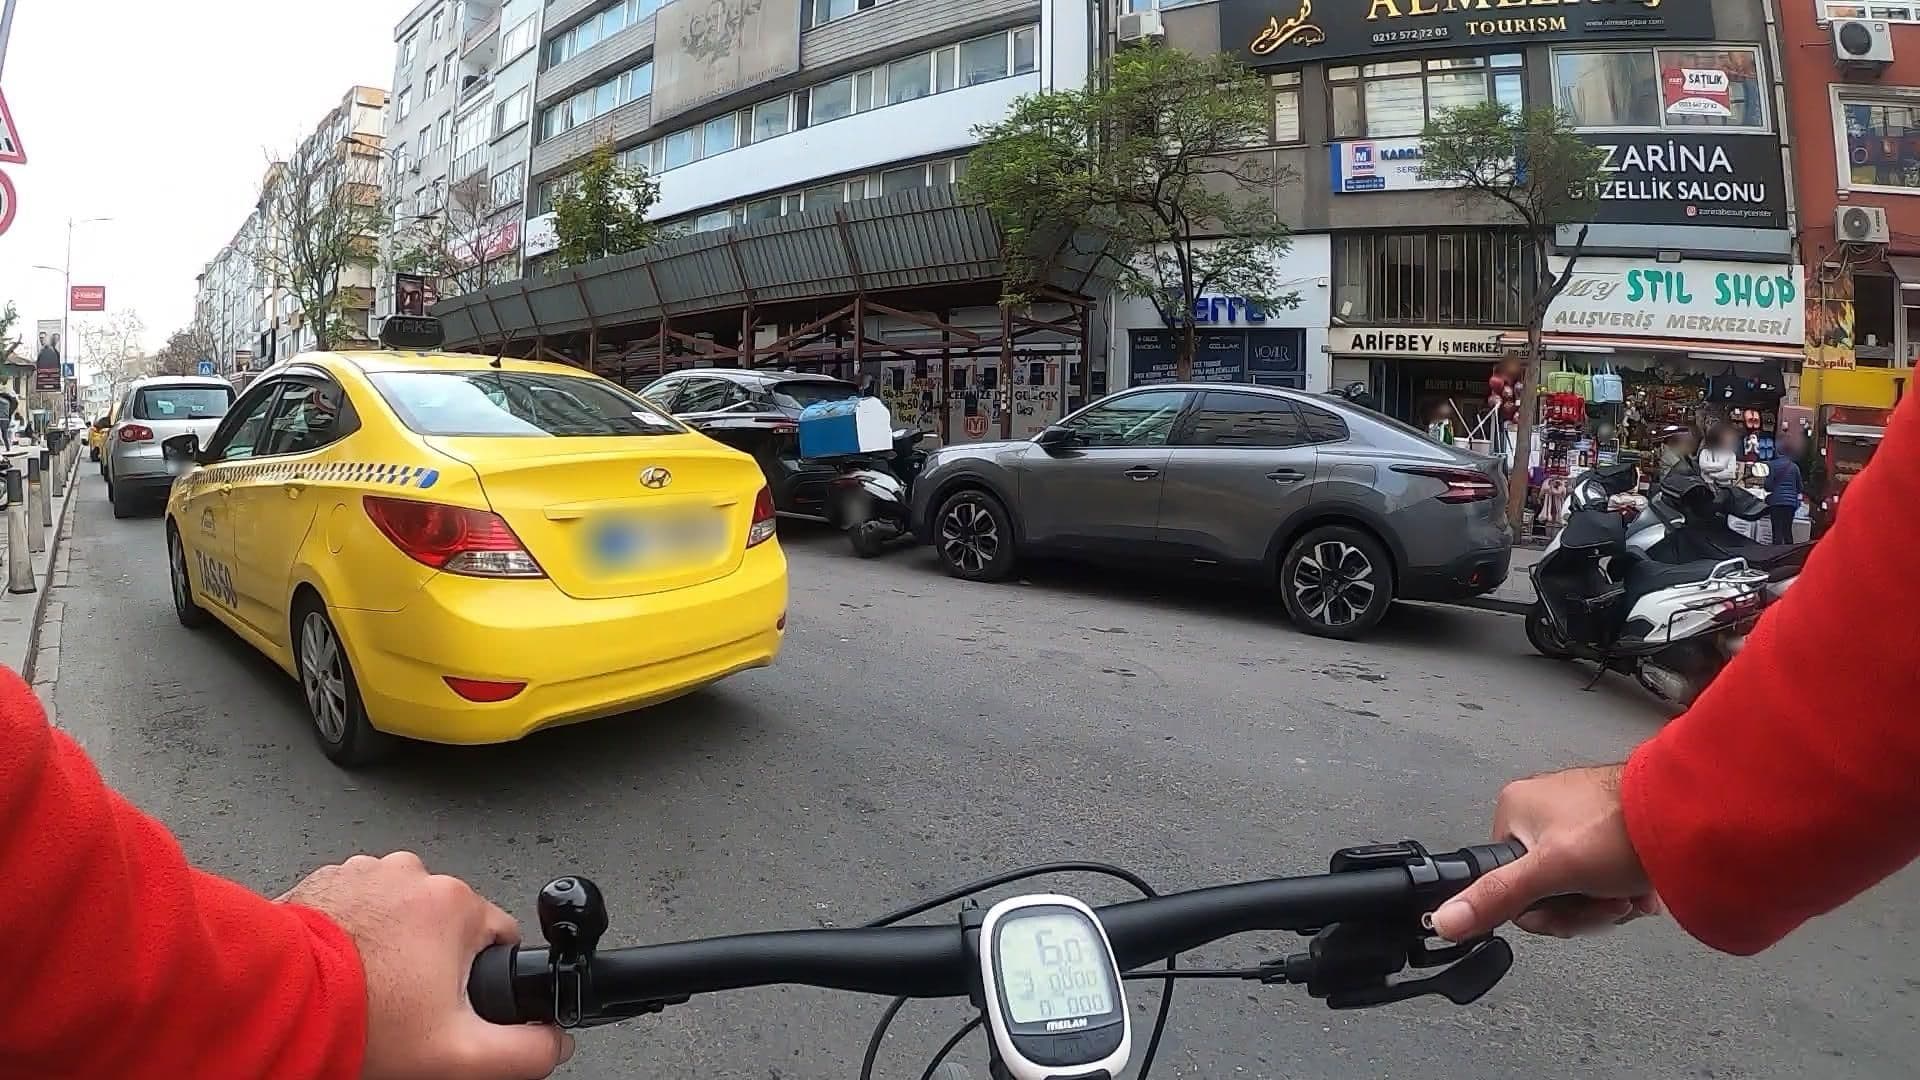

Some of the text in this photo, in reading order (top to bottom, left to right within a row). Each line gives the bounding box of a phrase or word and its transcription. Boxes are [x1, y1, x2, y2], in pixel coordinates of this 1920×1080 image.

[1373, 33, 1396, 42] 0212
[1400, 31, 1418, 40] 572
[1435, 28, 1447, 37] 03
[1466, 16, 1568, 36] TOURISM
[1688, 73, 1723, 85] SATILIK
[1596, 140, 1733, 173] ZARİNA
[1567, 176, 1765, 202] GÜZELLİK SALONU
[1626, 269, 1693, 304] STIL
[1714, 272, 1796, 308] SHOP
[1555, 310, 1792, 336] ALIŞVERİŞ MERKEZLERİ
[1351, 331, 1434, 352] ARİFBEY
